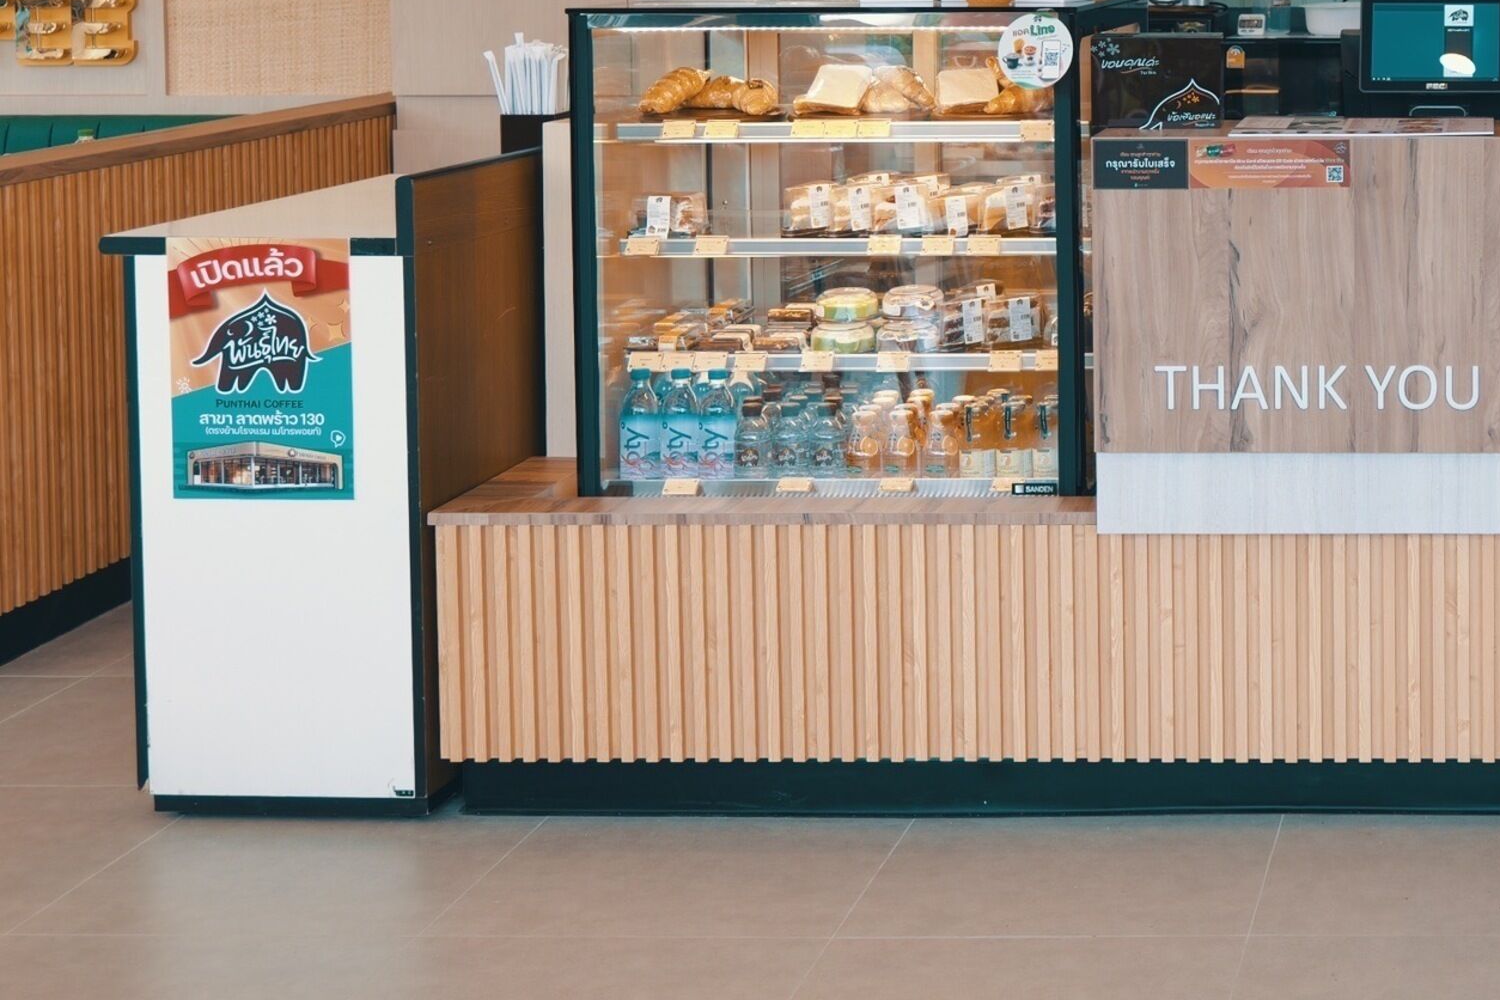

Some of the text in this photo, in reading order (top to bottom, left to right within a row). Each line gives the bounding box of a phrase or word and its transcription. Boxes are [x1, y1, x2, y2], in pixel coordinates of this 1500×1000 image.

[1105, 157, 1176, 171] กรุณารับใบเสร็จ
[190, 248, 304, 289] เปิดแล้ว
[1154, 365, 1480, 411] THANK YOU
[216, 399, 304, 409] PUNTHAI COFFEE
[199, 410, 325, 426] สาขา ลาดพร้าว 130
[1025, 485, 1053, 493] SANDEN
